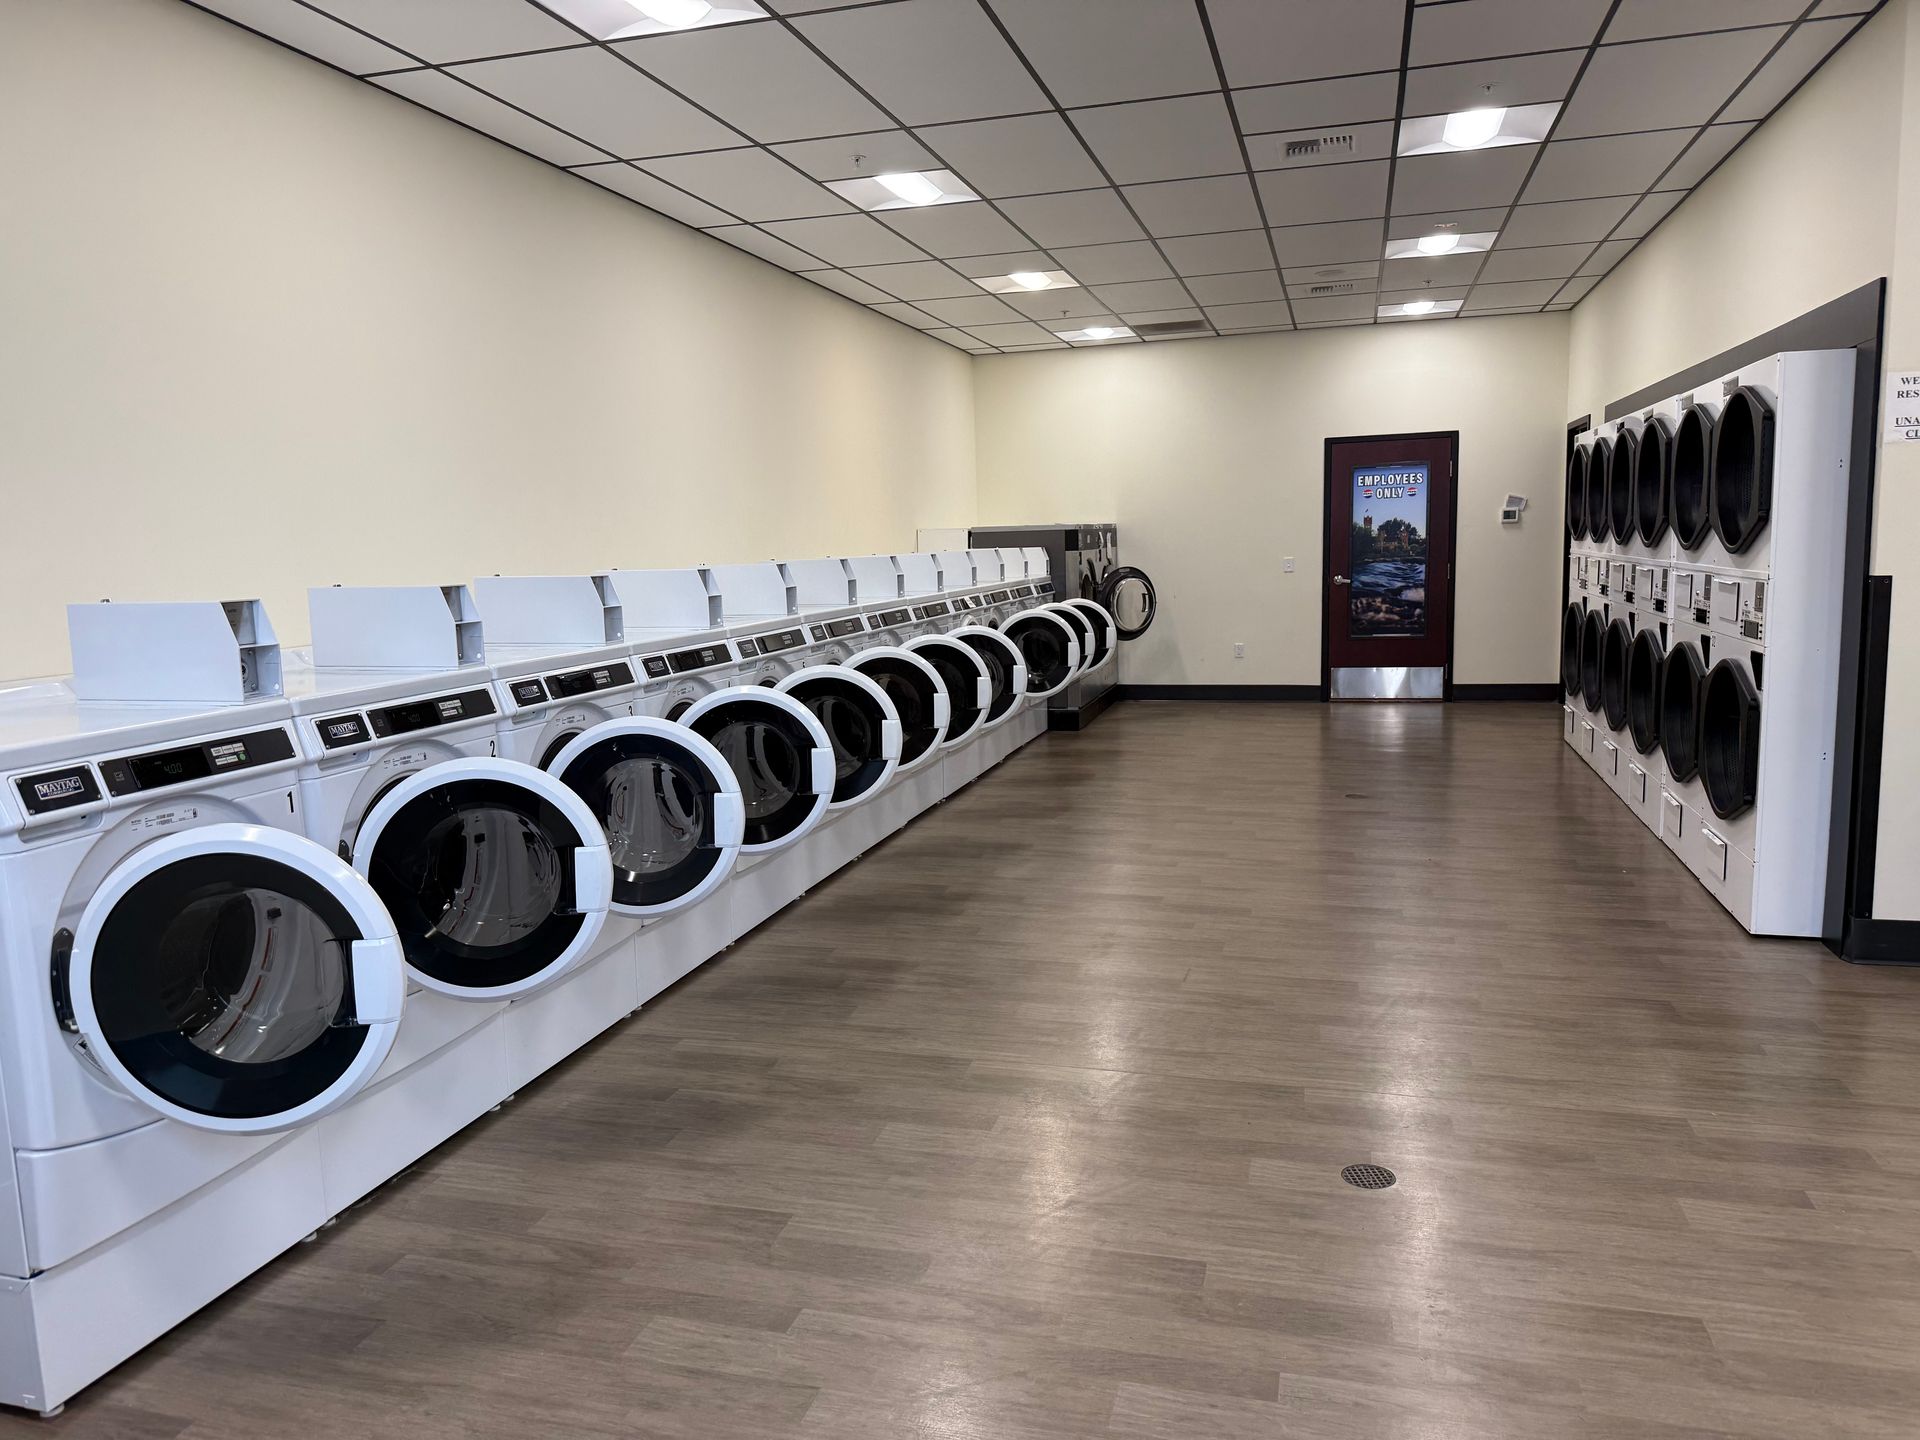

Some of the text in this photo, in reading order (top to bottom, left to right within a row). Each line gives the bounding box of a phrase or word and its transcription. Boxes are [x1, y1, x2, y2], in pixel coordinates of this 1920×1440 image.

[1897, 390, 1920, 399] RES
[1357, 472, 1423, 486] EMPLOYEES
[1376, 487, 1404, 499] ONLY
[489, 740, 496, 758] 2
[38, 778, 80, 795] MAYTAG
[286, 790, 295, 814] 1
